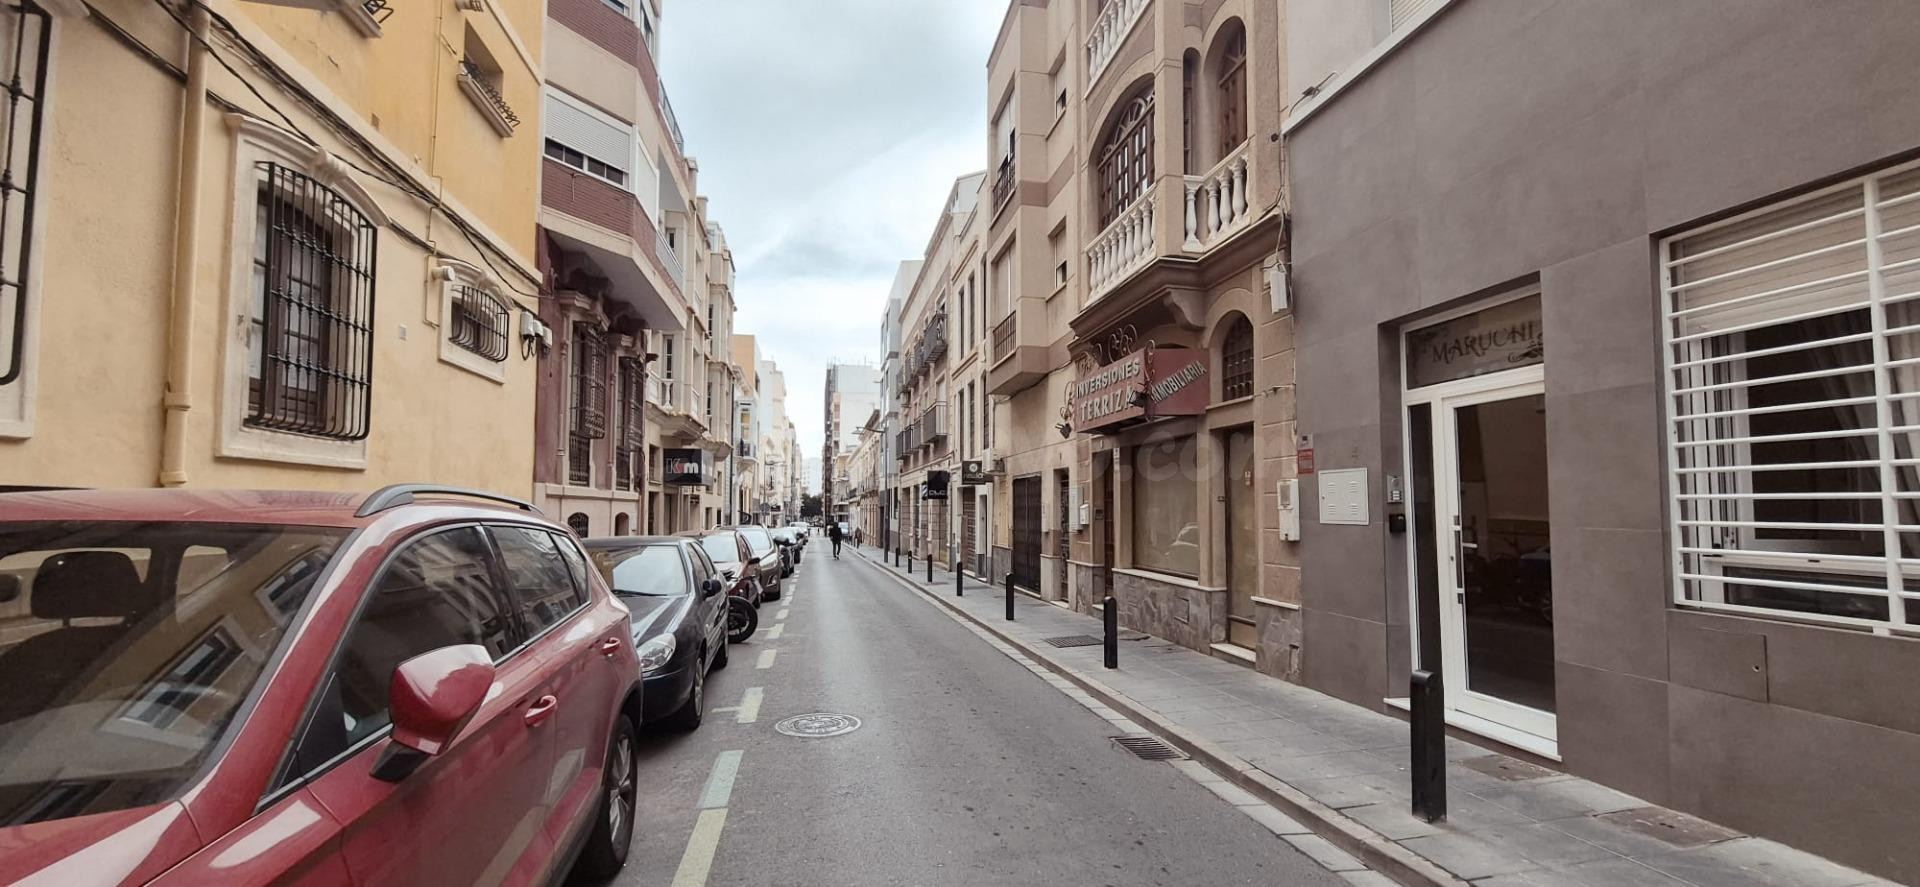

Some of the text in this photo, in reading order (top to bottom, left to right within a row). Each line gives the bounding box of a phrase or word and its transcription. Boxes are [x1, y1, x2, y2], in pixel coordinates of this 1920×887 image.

[1432, 320, 1533, 364] MARUCHI
[1076, 358, 1141, 399] INVERSIONES
[1151, 360, 1207, 404] INMOBILIARIA
[1080, 385, 1136, 423] TERRIZA
